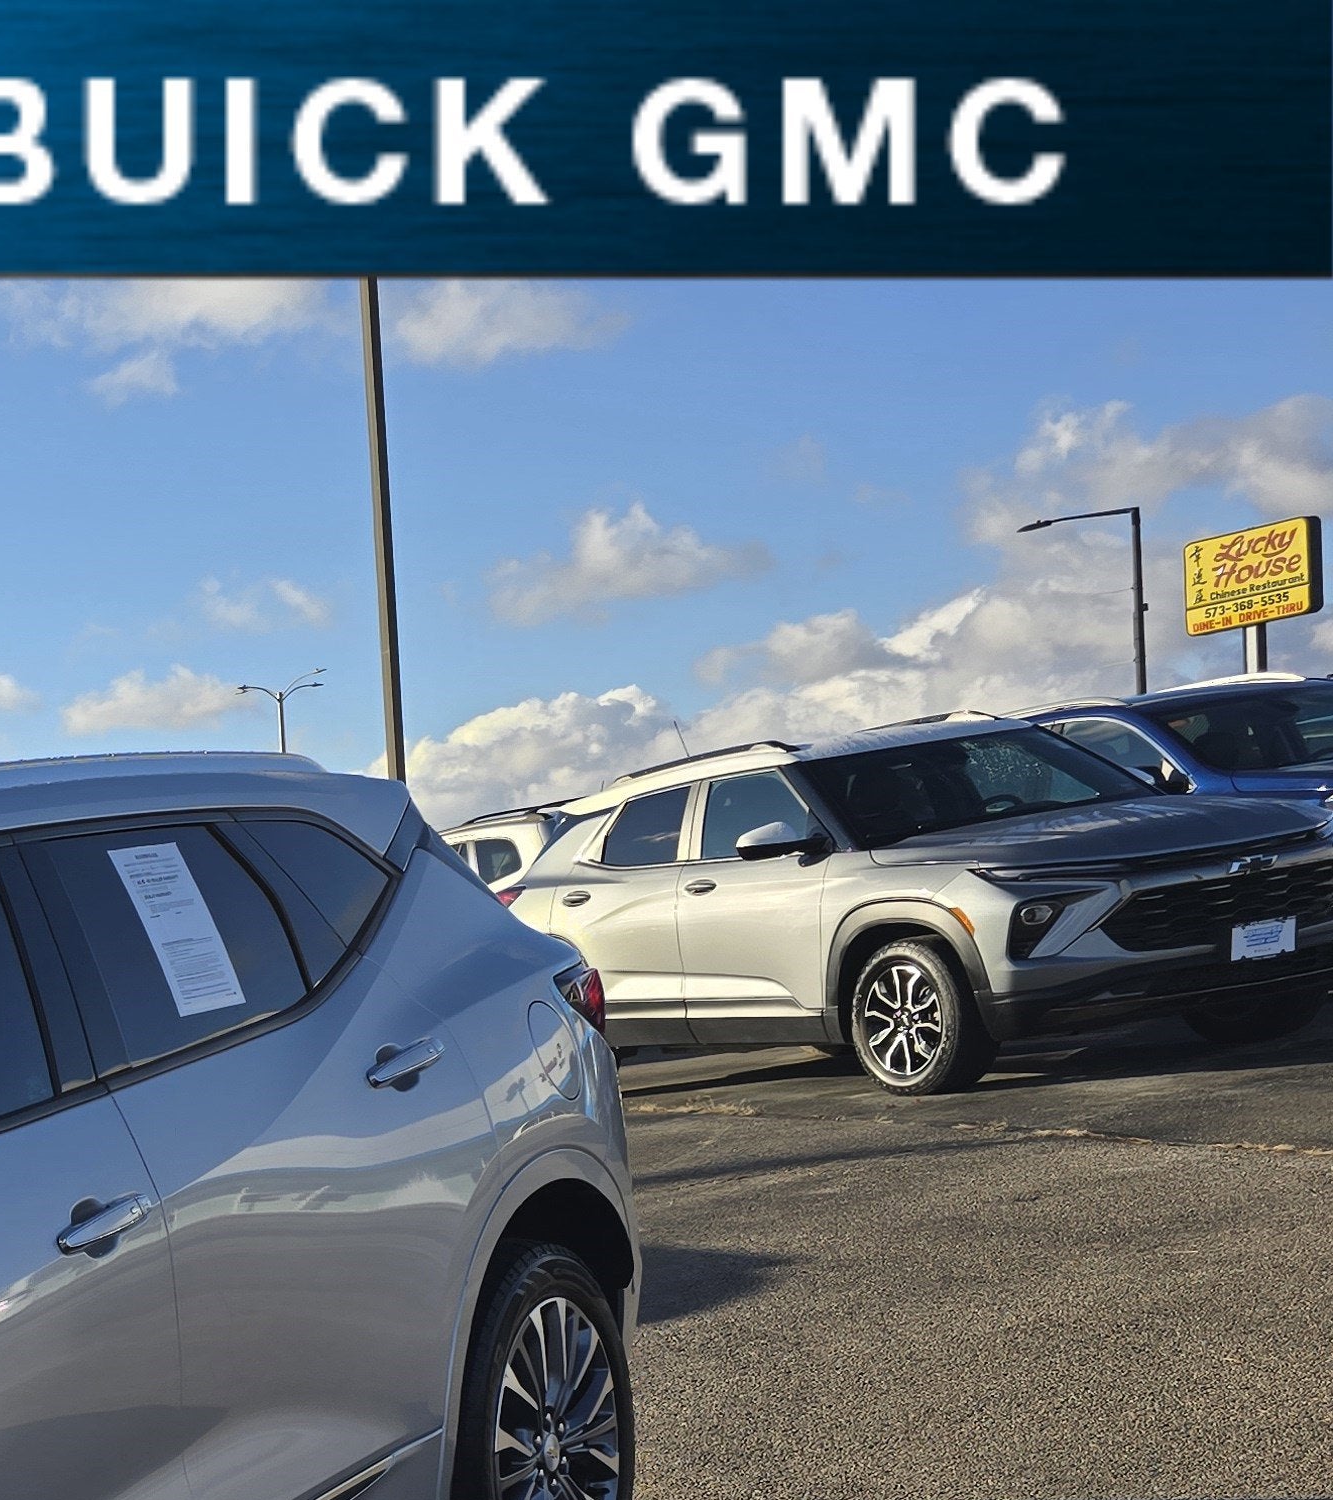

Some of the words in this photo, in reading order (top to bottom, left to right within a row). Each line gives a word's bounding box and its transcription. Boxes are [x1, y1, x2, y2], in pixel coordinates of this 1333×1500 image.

[1213, 527, 1298, 562] Lucky
[1210, 587, 1247, 601] Chinese
[1249, 573, 1305, 593] Restaurant
[1192, 615, 1233, 633] DINE-IN
[1238, 601, 1303, 623] DRIVE-THRU
[1204, 591, 1290, 618] 573-368-5535
